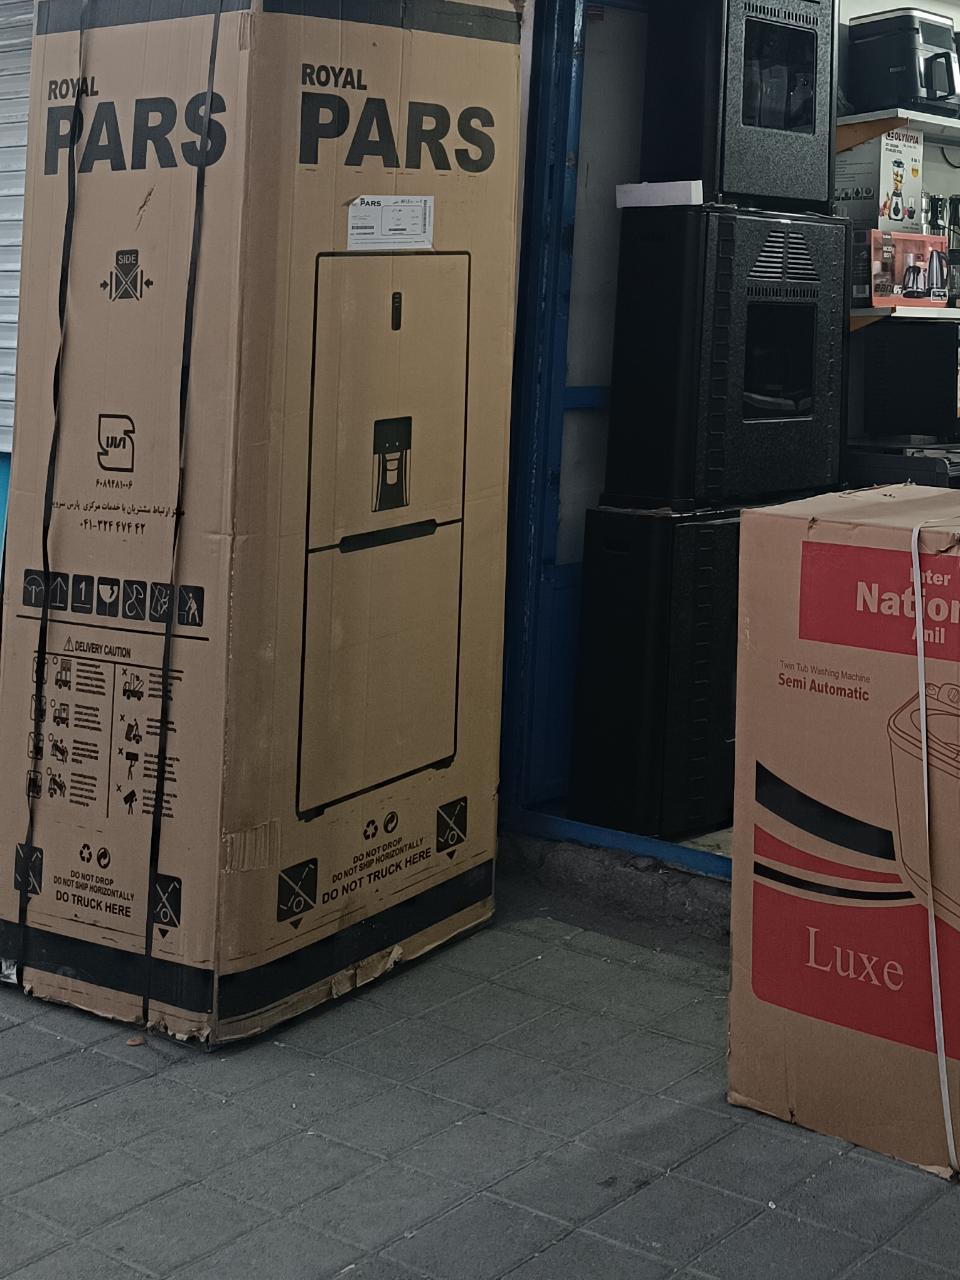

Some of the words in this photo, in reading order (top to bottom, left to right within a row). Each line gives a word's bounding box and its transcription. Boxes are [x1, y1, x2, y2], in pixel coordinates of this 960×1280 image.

[48, 75, 99, 101] ROYAL
[301, 62, 368, 91] ROYAL
[43, 91, 227, 176] PARS
[299, 91, 496, 174] PARS
[894, 131, 919, 145] OLYMPIA
[118, 254, 137, 265] SIDE
[74, 640, 103, 655] DELIVERY
[103, 642, 131, 659] CAUTION
[779, 659, 795, 670] Twin
[796, 662, 809, 674] Tub
[809, 664, 839, 682] Washing
[840, 669, 871, 684] Machine
[777, 672, 807, 693] Semi
[808, 677, 870, 702] Automatic
[332, 873, 343, 884] DO
[343, 866, 358, 879] NOT
[358, 858, 375, 872] SHIP
[375, 837, 424, 867] HORIZONTALLY
[353, 853, 365, 865] DO
[365, 846, 381, 860] NOT
[382, 837, 403, 855] DROP
[53, 875, 62, 885] DO
[62, 877, 75, 887] NOT
[75, 879, 89, 891] SHIP
[88, 881, 135, 902] HORIZONTALLY
[70, 870, 80, 879] DO
[80, 871, 95, 882] NOT
[95, 874, 114, 886] DROP
[322, 889, 339, 905] DO
[341, 877, 363, 896] NOT
[367, 861, 402, 885] TRUCK
[404, 847, 432, 868] HERE
[55, 891, 70, 903] DO
[71, 893, 103, 912] TRUCK
[104, 901, 132, 919] HERE
[804, 925, 904, 991] Luxe
